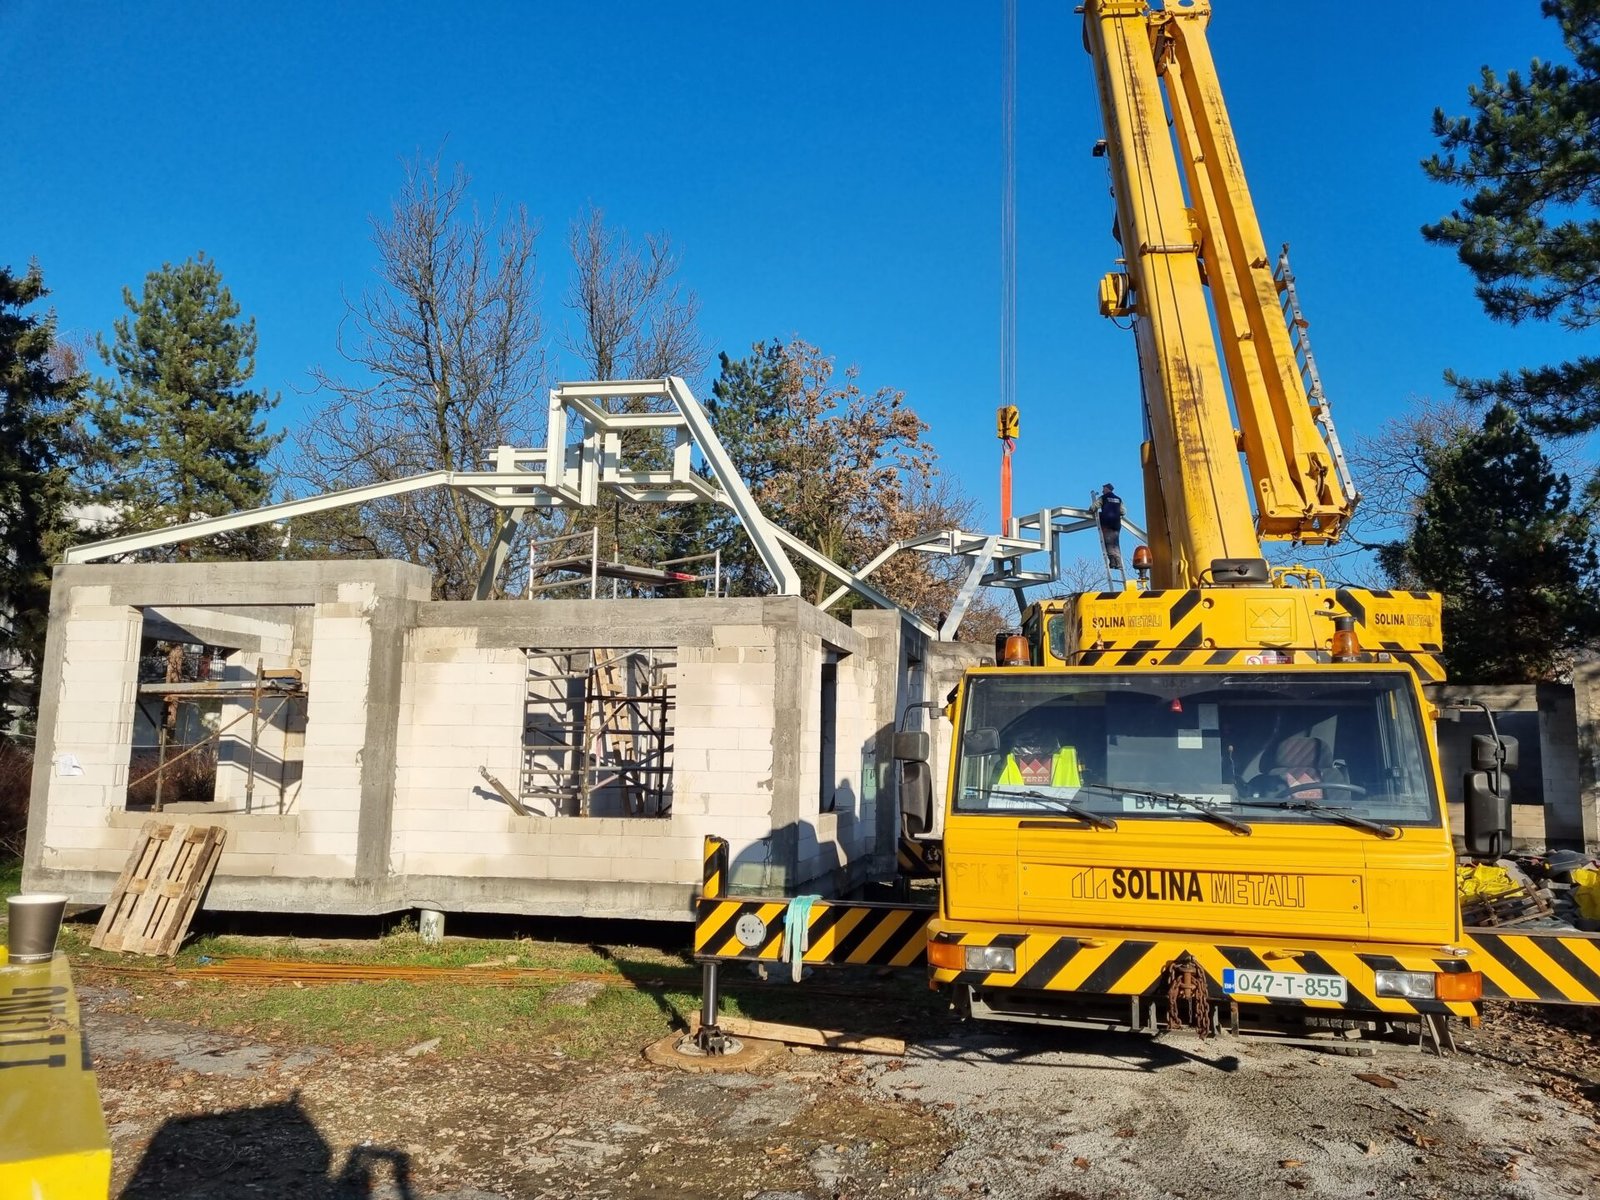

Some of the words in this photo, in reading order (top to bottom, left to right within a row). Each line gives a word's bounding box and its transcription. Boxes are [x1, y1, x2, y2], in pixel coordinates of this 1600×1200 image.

[1092, 616, 1126, 628] SOLINA
[1127, 616, 1163, 628] METALI
[1375, 613, 1406, 626] SOLINA
[1407, 614, 1435, 627] METALI
[1112, 868, 1204, 902] SOLINA
[1210, 872, 1305, 908] METALI
[1238, 973, 1342, 998] 047-T-855
